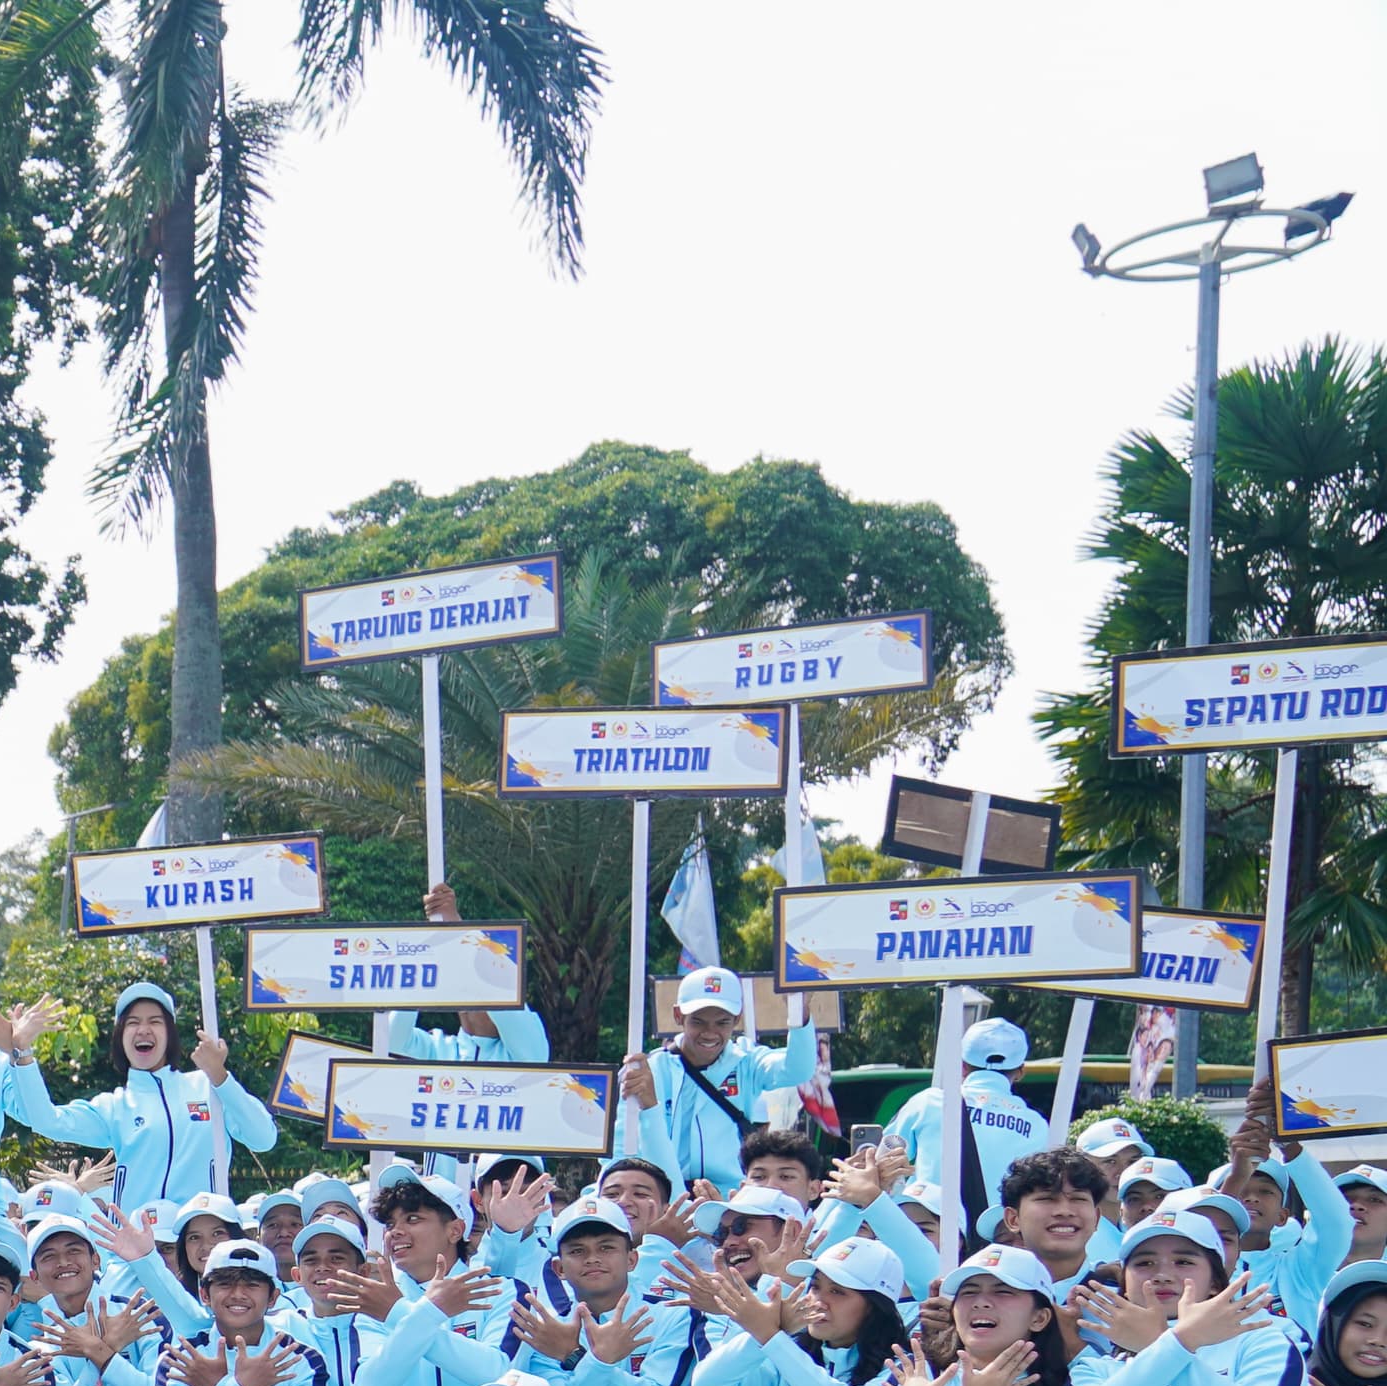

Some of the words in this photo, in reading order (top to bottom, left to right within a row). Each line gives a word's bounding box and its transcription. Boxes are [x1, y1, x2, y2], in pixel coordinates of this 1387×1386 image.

[331, 611, 422, 644] TARUNG
[429, 594, 531, 630] DERAJAT
[736, 656, 843, 688] RUGBY
[1185, 691, 1310, 727] SEPATU
[573, 747, 710, 773] TRIATHLON
[145, 877, 254, 908] KURASH
[970, 898, 1015, 917] bogor
[875, 925, 1034, 961] PANAHAN
[330, 964, 438, 989] SAMBO
[411, 1103, 524, 1131] SELAM
[987, 1111, 1032, 1138] BOGOR
